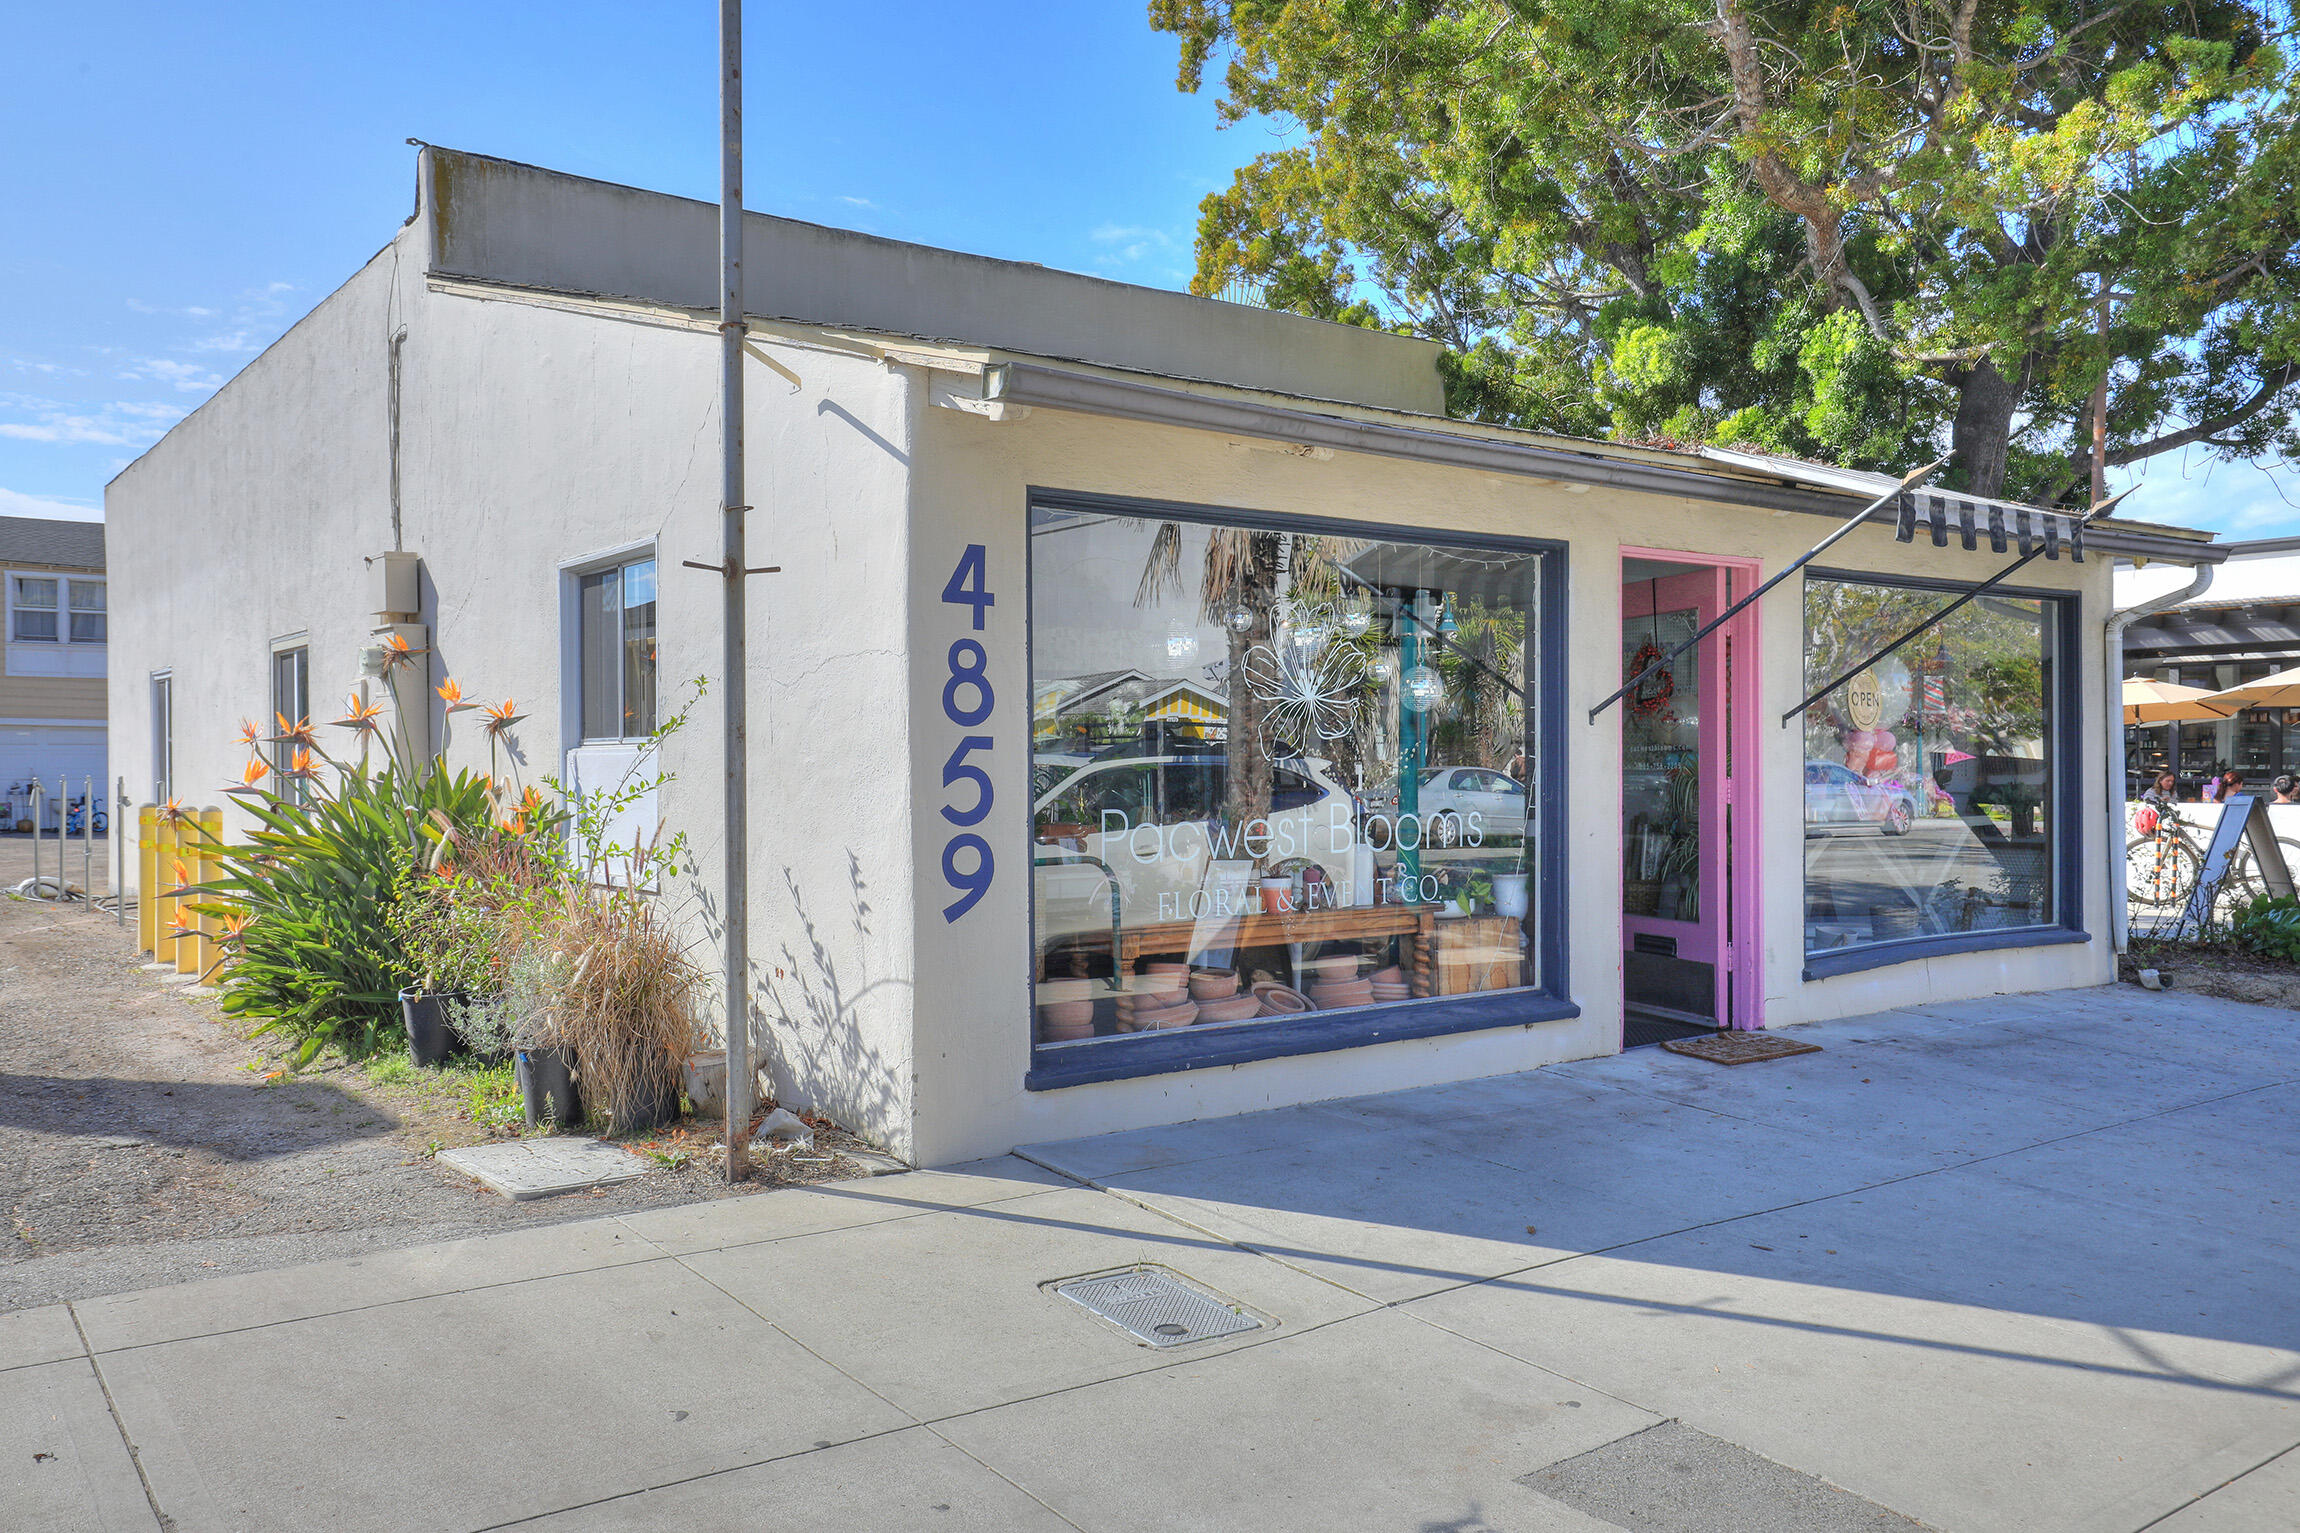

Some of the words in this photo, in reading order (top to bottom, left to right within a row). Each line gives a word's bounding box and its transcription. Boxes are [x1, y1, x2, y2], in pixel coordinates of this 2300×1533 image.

[1851, 691, 1880, 707] OPEN
[940, 544, 995, 924] 4859
[1101, 804, 1314, 866] Pacwest
[1330, 802, 1484, 854] Blooms
[1158, 887, 1268, 921] FLORAL
[1276, 886, 1299, 912] &
[1401, 874, 1443, 902] CO.
